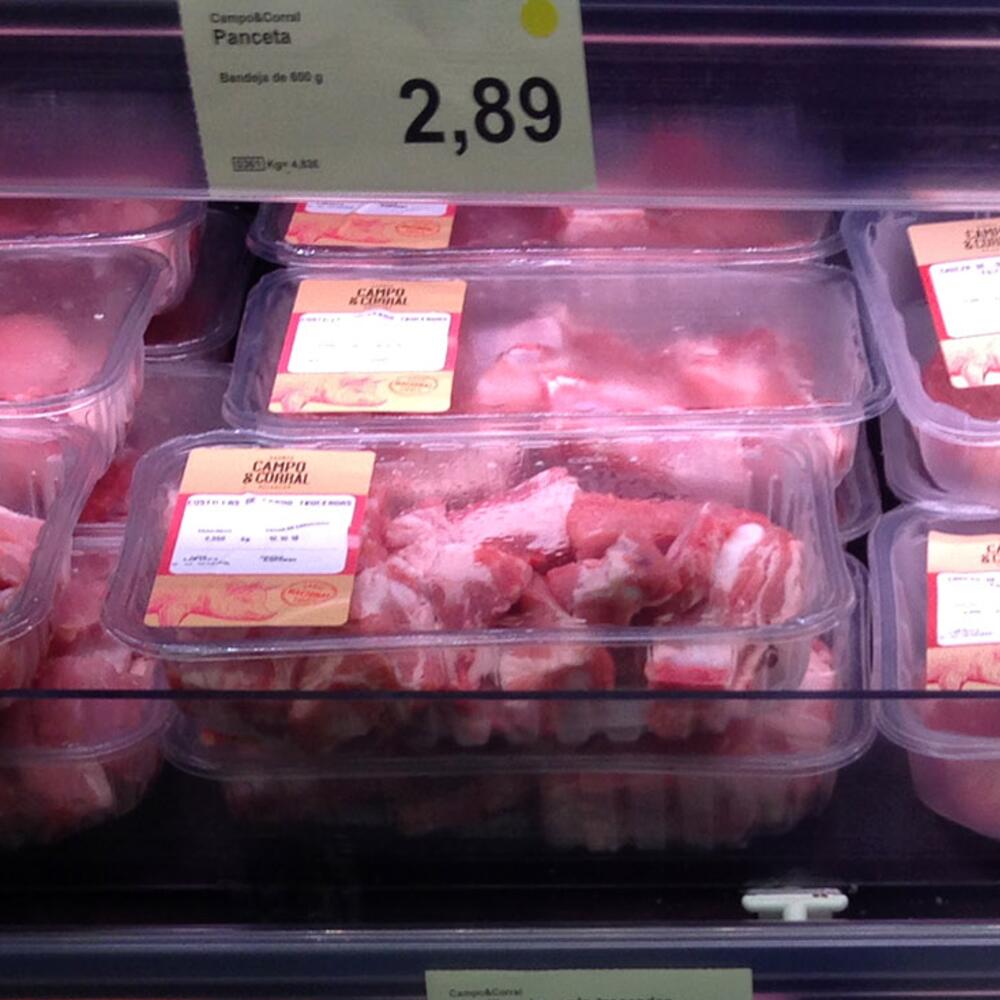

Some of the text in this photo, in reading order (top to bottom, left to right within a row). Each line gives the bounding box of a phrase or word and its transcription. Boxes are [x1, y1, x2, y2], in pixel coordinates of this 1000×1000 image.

[213, 29, 292, 45] Panceta
[220, 71, 269, 85] Bandeja
[272, 71, 288, 83] de
[314, 73, 324, 85] g
[399, 76, 562, 156] 2,89
[356, 288, 406, 298] CAMPO
[252, 461, 306, 473] CAMPO
